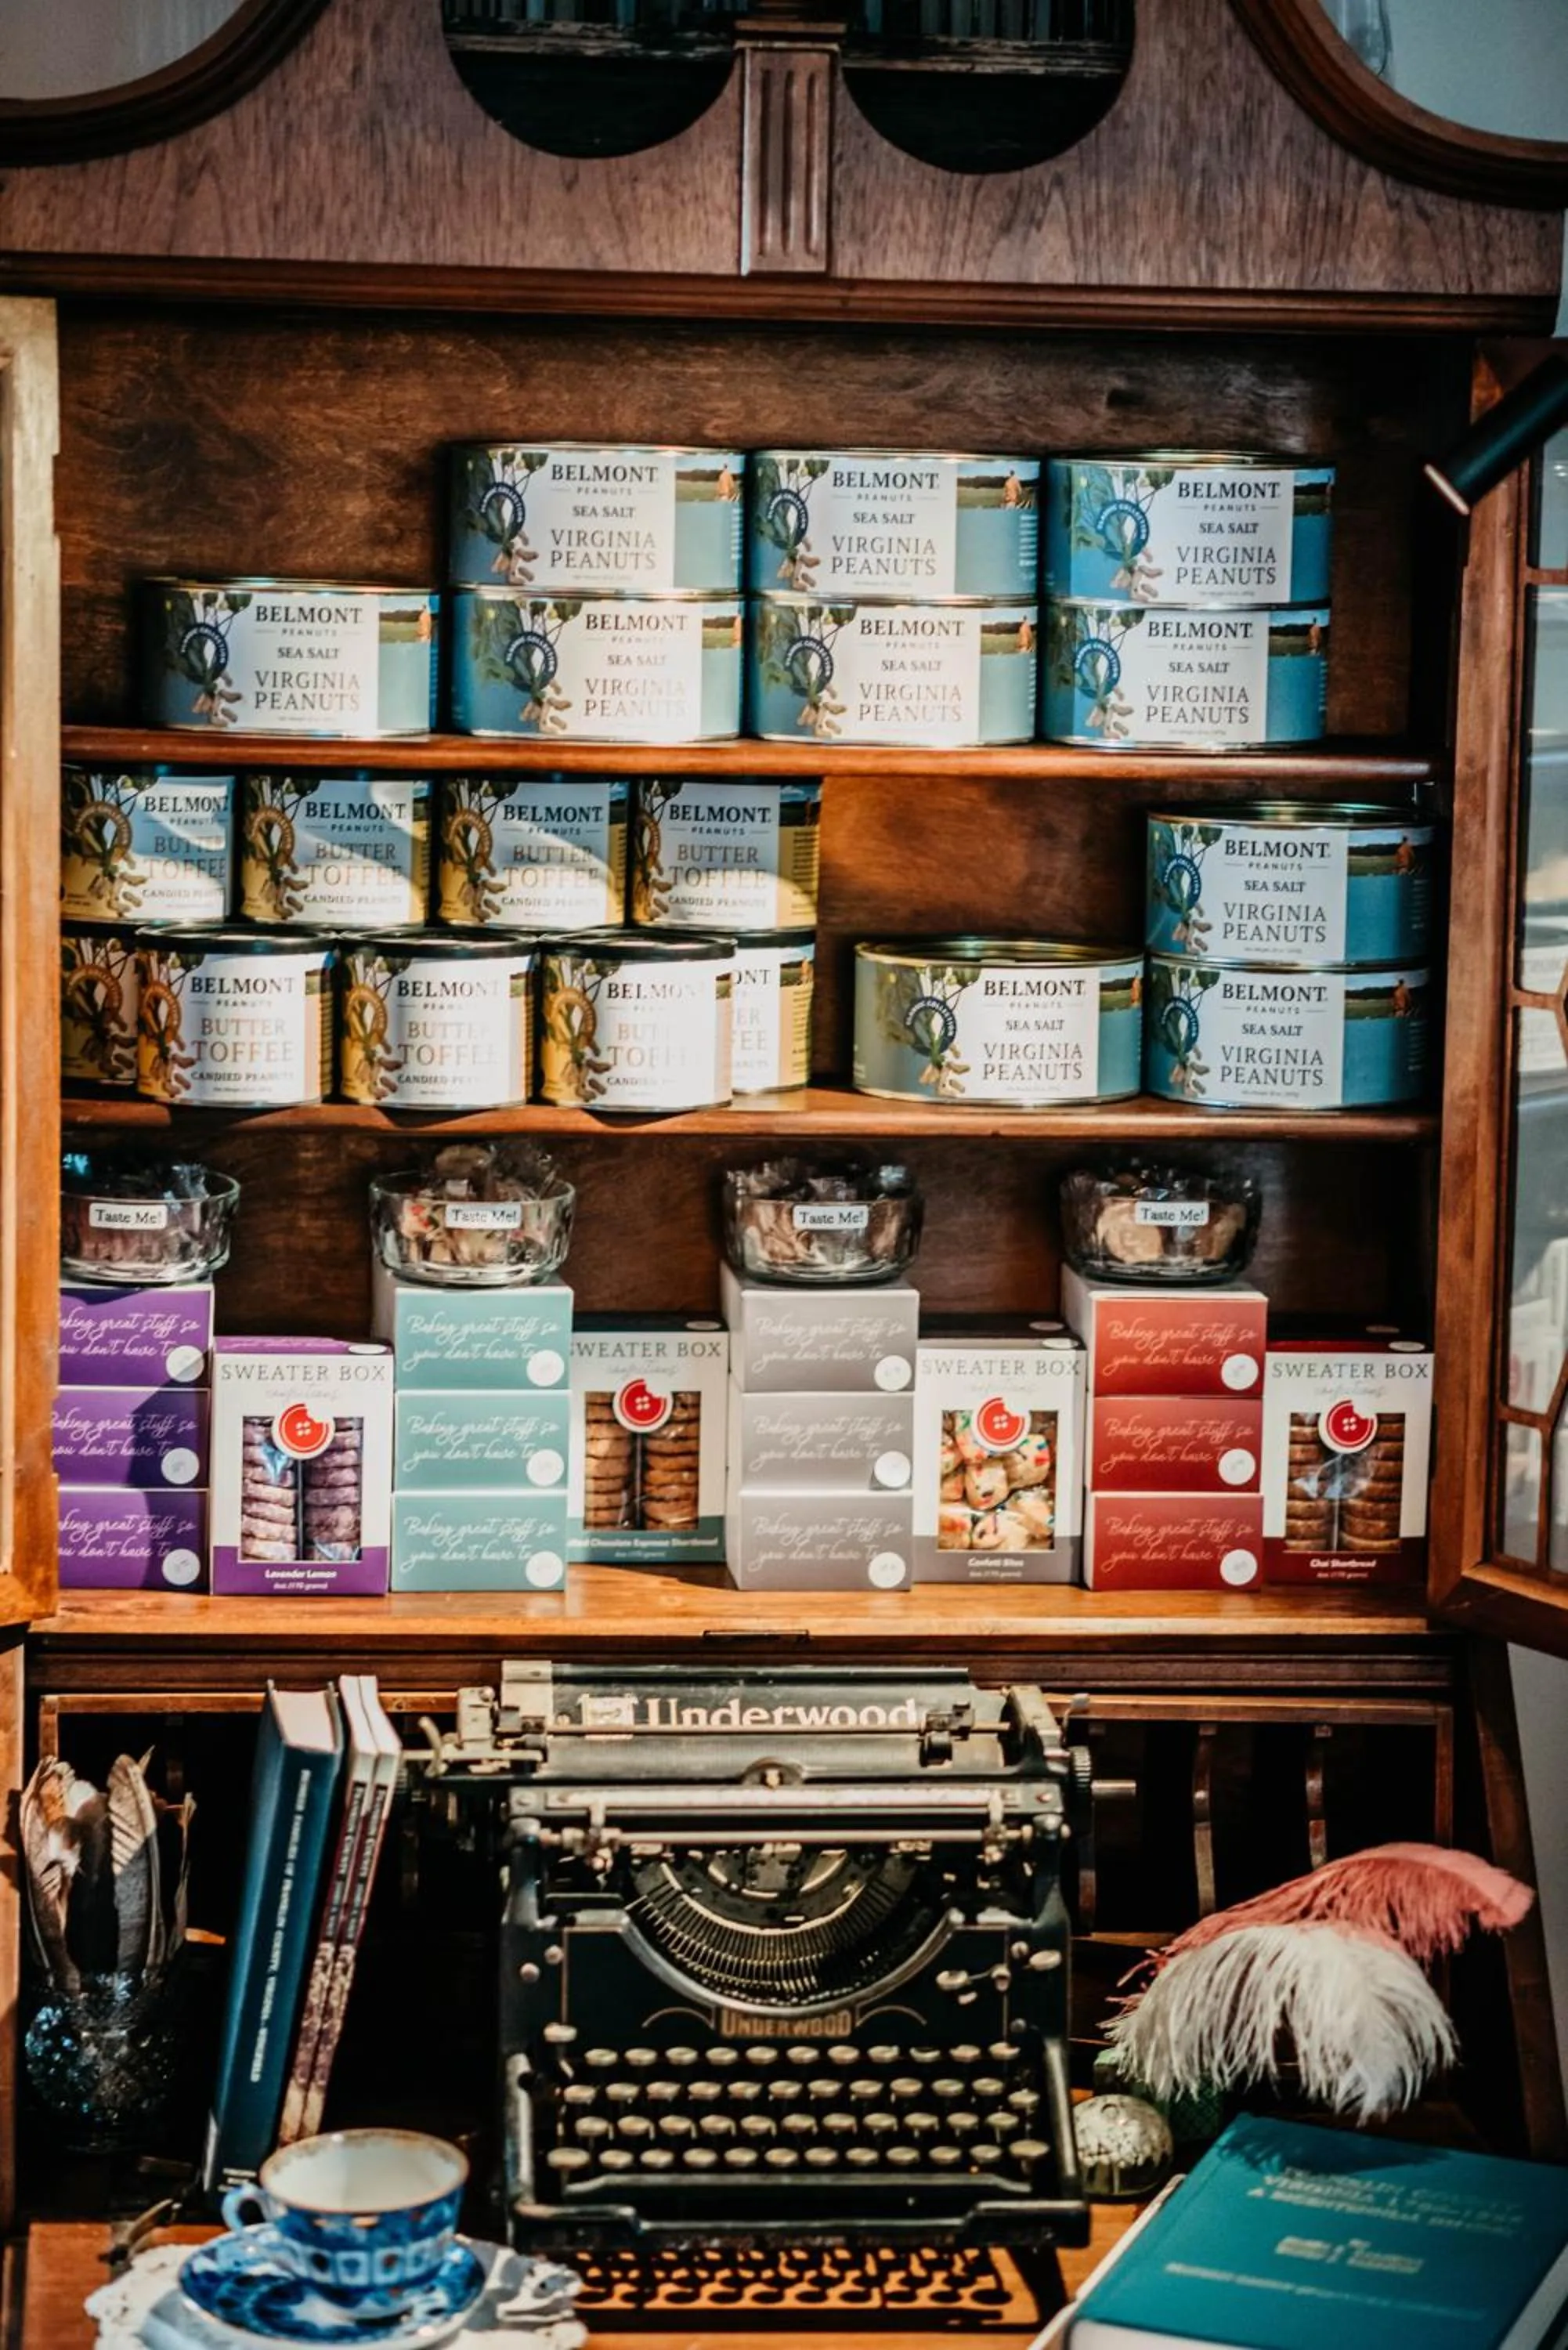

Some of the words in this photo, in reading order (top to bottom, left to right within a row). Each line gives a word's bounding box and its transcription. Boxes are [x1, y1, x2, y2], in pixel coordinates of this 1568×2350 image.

[551, 465, 658, 483] BELMONT
[833, 472, 939, 490] BELMONT
[1178, 483, 1280, 498] BELMONT
[573, 506, 598, 517] SEA
[603, 506, 635, 518] SALT
[853, 512, 879, 523] SEA
[883, 513, 916, 524] SALT
[1199, 522, 1223, 533] SEA
[1227, 523, 1259, 534] SALT
[551, 530, 656, 548] VIRGINIA
[832, 536, 937, 555] VIRGINIA
[551, 551, 656, 569] PEANUTS
[1177, 547, 1276, 564] VIRGINIA
[830, 557, 937, 576] PEANUTS
[1176, 567, 1276, 584] PEANUTS
[256, 606, 363, 624] BELMONT
[587, 614, 688, 631] BELMONT
[861, 620, 964, 637] BELMONT
[1148, 622, 1252, 638] BELMONT
[278, 647, 303, 658] SEA
[307, 648, 340, 659] SALT
[608, 655, 632, 665] SEA
[637, 656, 667, 666] SALT
[881, 660, 906, 671] SEA
[911, 661, 942, 671] SALT
[1169, 663, 1193, 673] SEA
[1198, 663, 1230, 673] SALT
[255, 671, 359, 690] VIRGINIA
[860, 683, 962, 702] VIRGINIA
[1147, 685, 1249, 703] VIRGINIA
[255, 692, 360, 711] PEANUTS
[859, 705, 963, 722] PEANUTS
[1146, 707, 1249, 724] PEANUTS
[143, 796, 229, 813] BELMONT
[305, 802, 406, 819] BELMONT
[503, 804, 603, 822] BELMONT
[669, 804, 771, 822] BELMONT
[316, 843, 396, 859] BUTTER
[678, 844, 759, 862] BUTTER
[1225, 840, 1330, 859] BELMONT
[305, 865, 403, 886] TOFFEE
[669, 866, 767, 888] TOFFEE
[1245, 880, 1269, 891] SEA
[1274, 881, 1306, 892] SALT
[1224, 902, 1327, 922] VIRGINIA
[1223, 924, 1327, 942] PEANUTS
[190, 977, 294, 994] BELMONT
[985, 980, 1085, 996] BELMONT
[1223, 983, 1328, 1002] BELMONT
[201, 1019, 286, 1036] BUTTER
[1006, 1020, 1030, 1031] SEA
[1035, 1020, 1064, 1031] SALT
[1241, 1024, 1266, 1035] SEA
[1270, 1025, 1303, 1036] SALT
[190, 1040, 295, 1062] TOFFEE
[984, 1043, 1083, 1060] VIRGINIA
[1222, 1046, 1324, 1065] VIRGINIA
[982, 1063, 1083, 1080] PEANUTS
[1221, 1066, 1324, 1086] PEANUTS
[95, 1209, 130, 1223] Taste
[451, 1209, 487, 1224] Taste
[798, 1212, 833, 1224] Taste
[1140, 1207, 1175, 1221] Taste
[677, 1343, 721, 1358] BOX
[221, 1365, 328, 1381] SWEATER
[339, 1365, 385, 1381] BOX
[921, 1359, 1024, 1376] SWEATER
[1035, 1360, 1080, 1376] BOX
[1272, 1363, 1375, 1379] SWEATER
[1386, 1364, 1428, 1378] BOX
[265, 1570, 305, 1578] Lavender
[307, 1570, 337, 1578] Lemon
[646, 1696, 917, 1726] Underwood
[721, 2008, 852, 2037] UNDERWOOD
